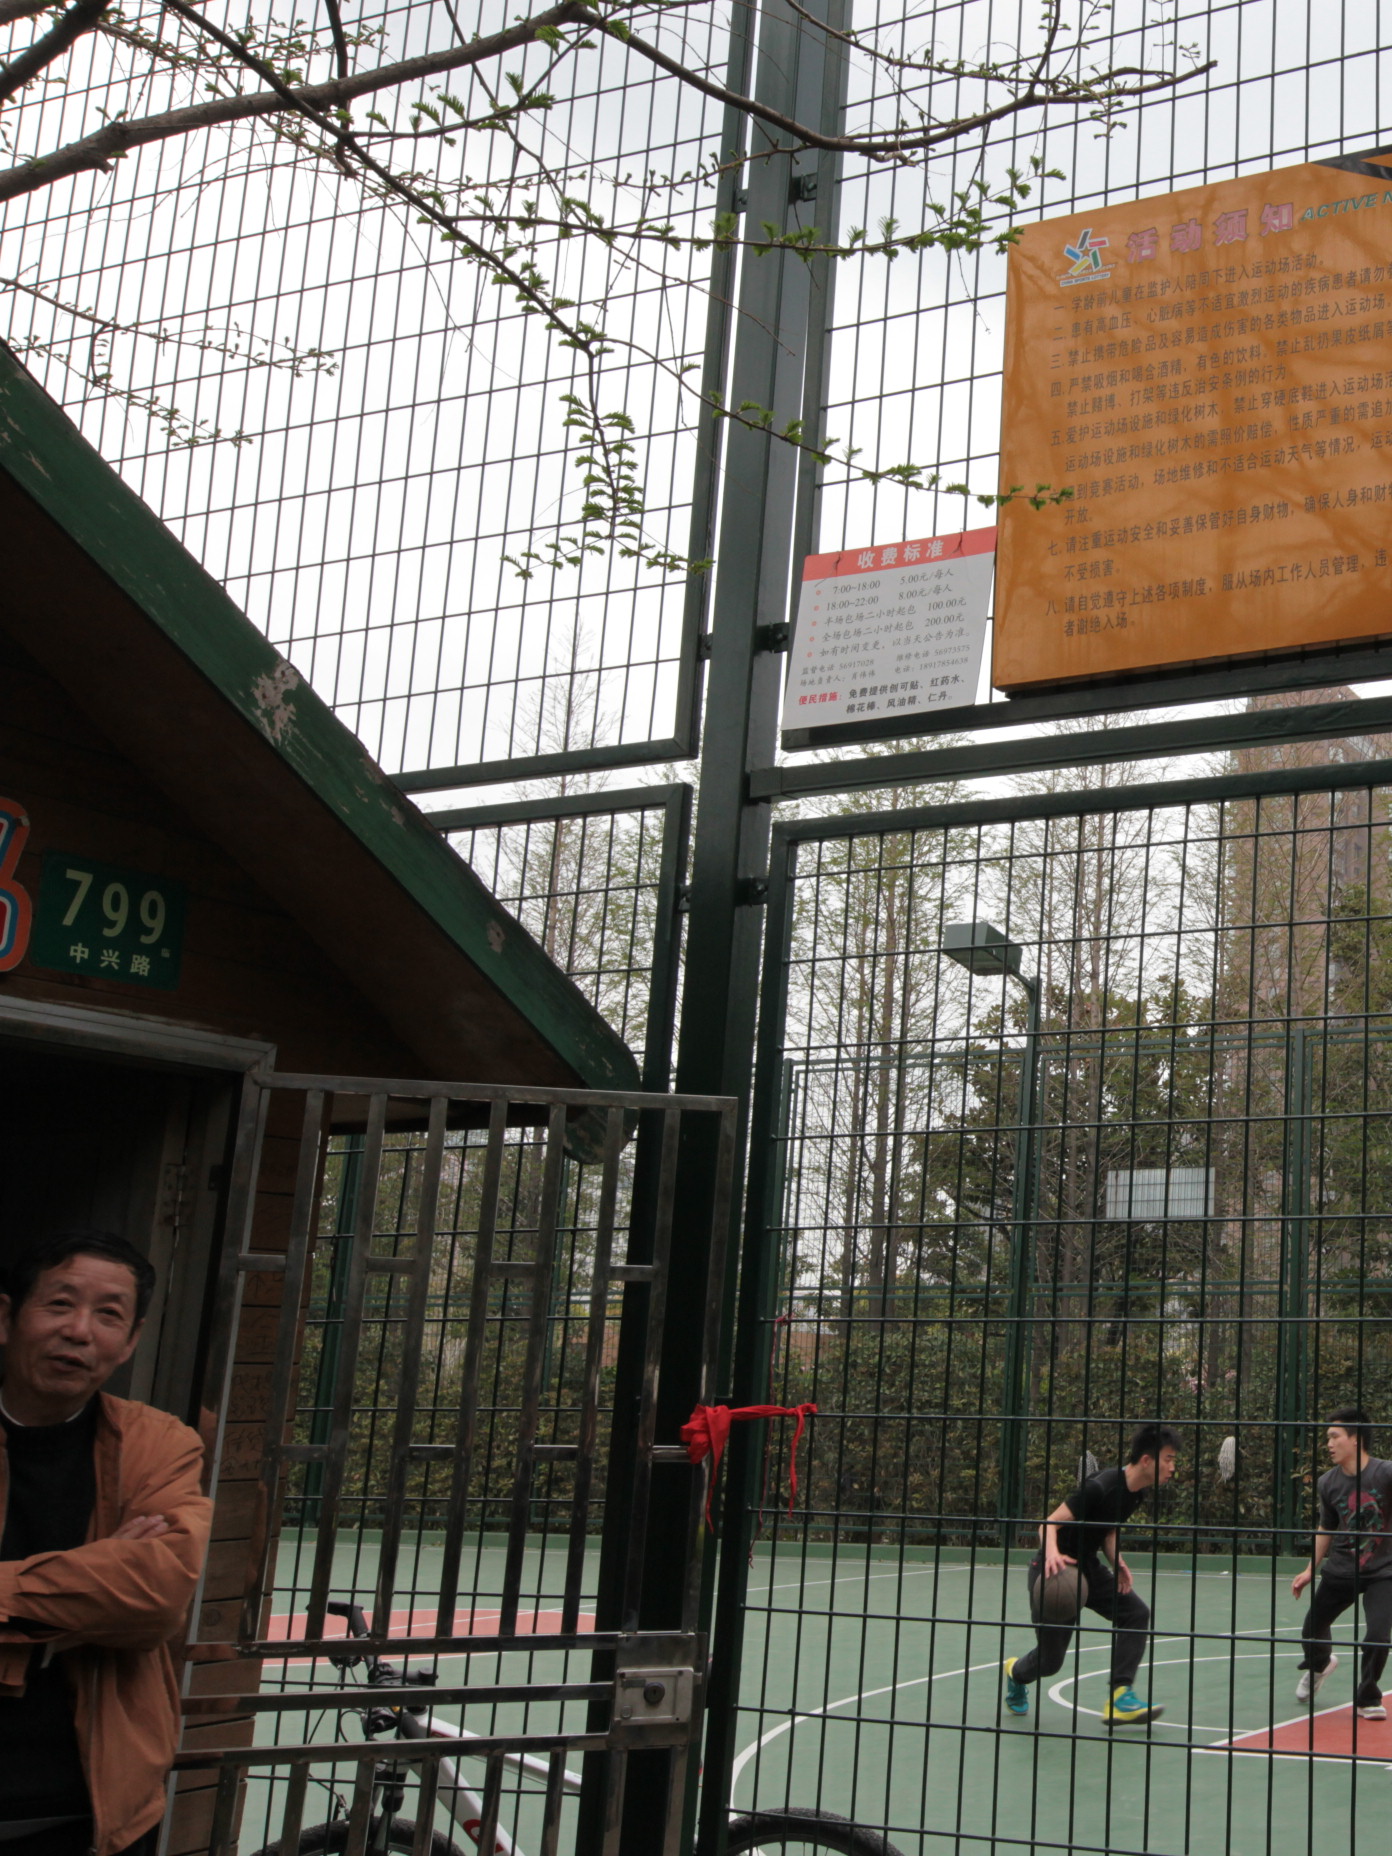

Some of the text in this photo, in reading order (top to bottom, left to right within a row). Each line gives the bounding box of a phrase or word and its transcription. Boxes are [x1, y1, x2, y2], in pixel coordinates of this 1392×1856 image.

[1300, 193, 1378, 221] ACTIVE
[1123, 202, 1294, 263] 活动须知
[857, 540, 945, 569] 收费标准
[833, 580, 880, 595] 7:00~18:00
[62, 867, 166, 945] 799
[69, 942, 151, 977] 中兴路
